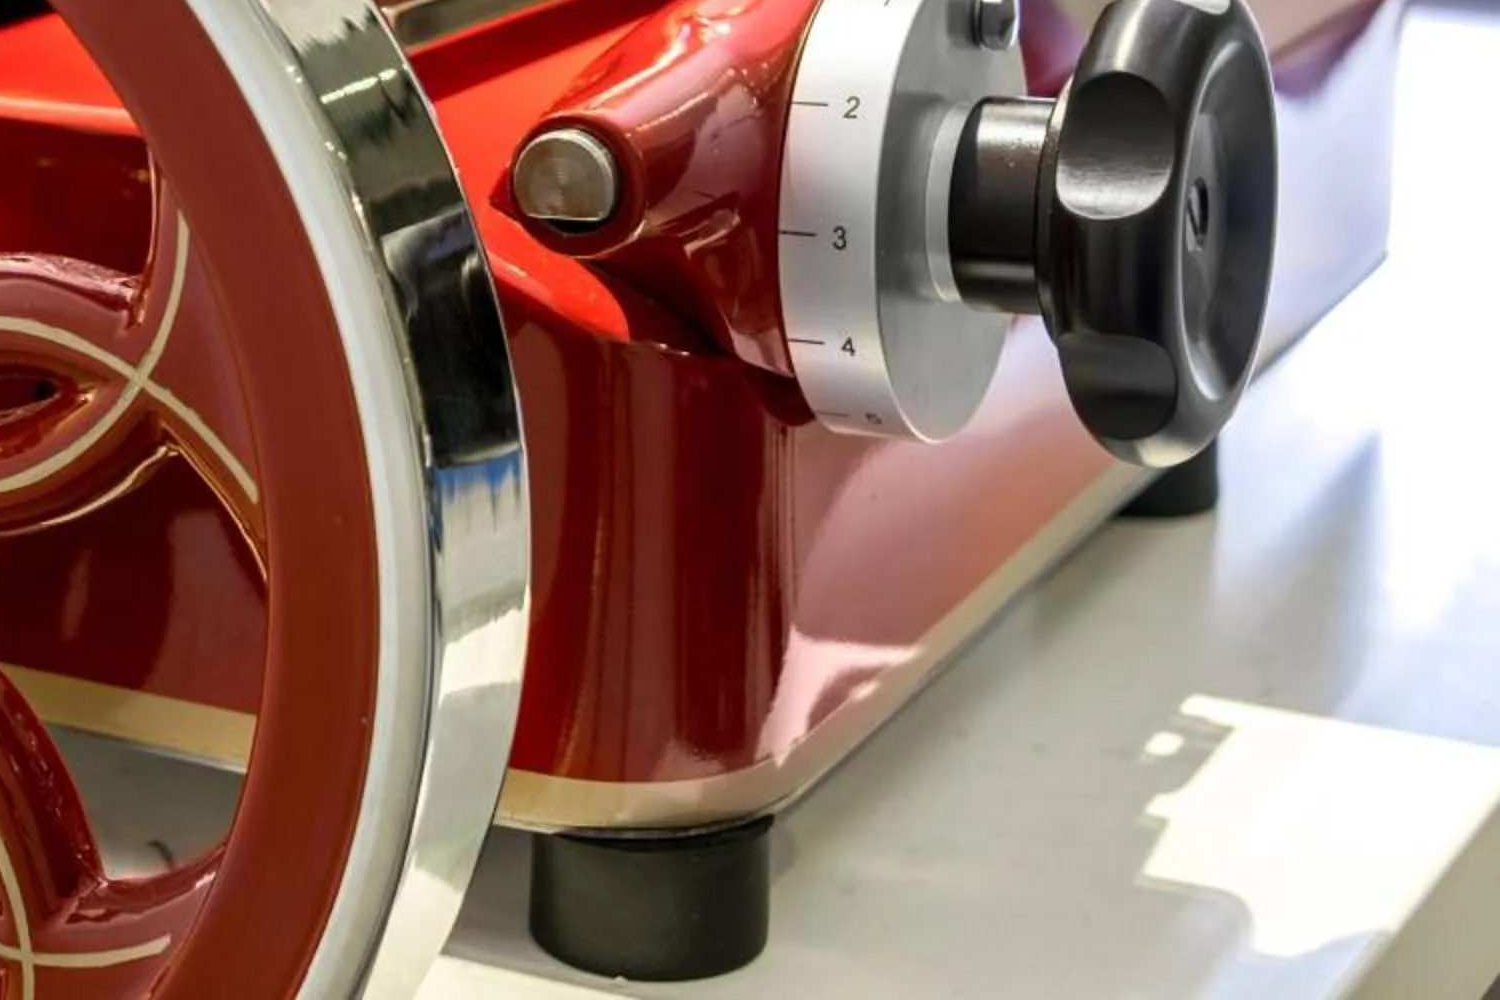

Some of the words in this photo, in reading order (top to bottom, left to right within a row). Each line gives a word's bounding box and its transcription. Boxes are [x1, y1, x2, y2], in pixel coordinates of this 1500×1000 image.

[843, 95, 861, 119] 2
[832, 225, 847, 251] 3
[841, 335, 856, 357] 4
